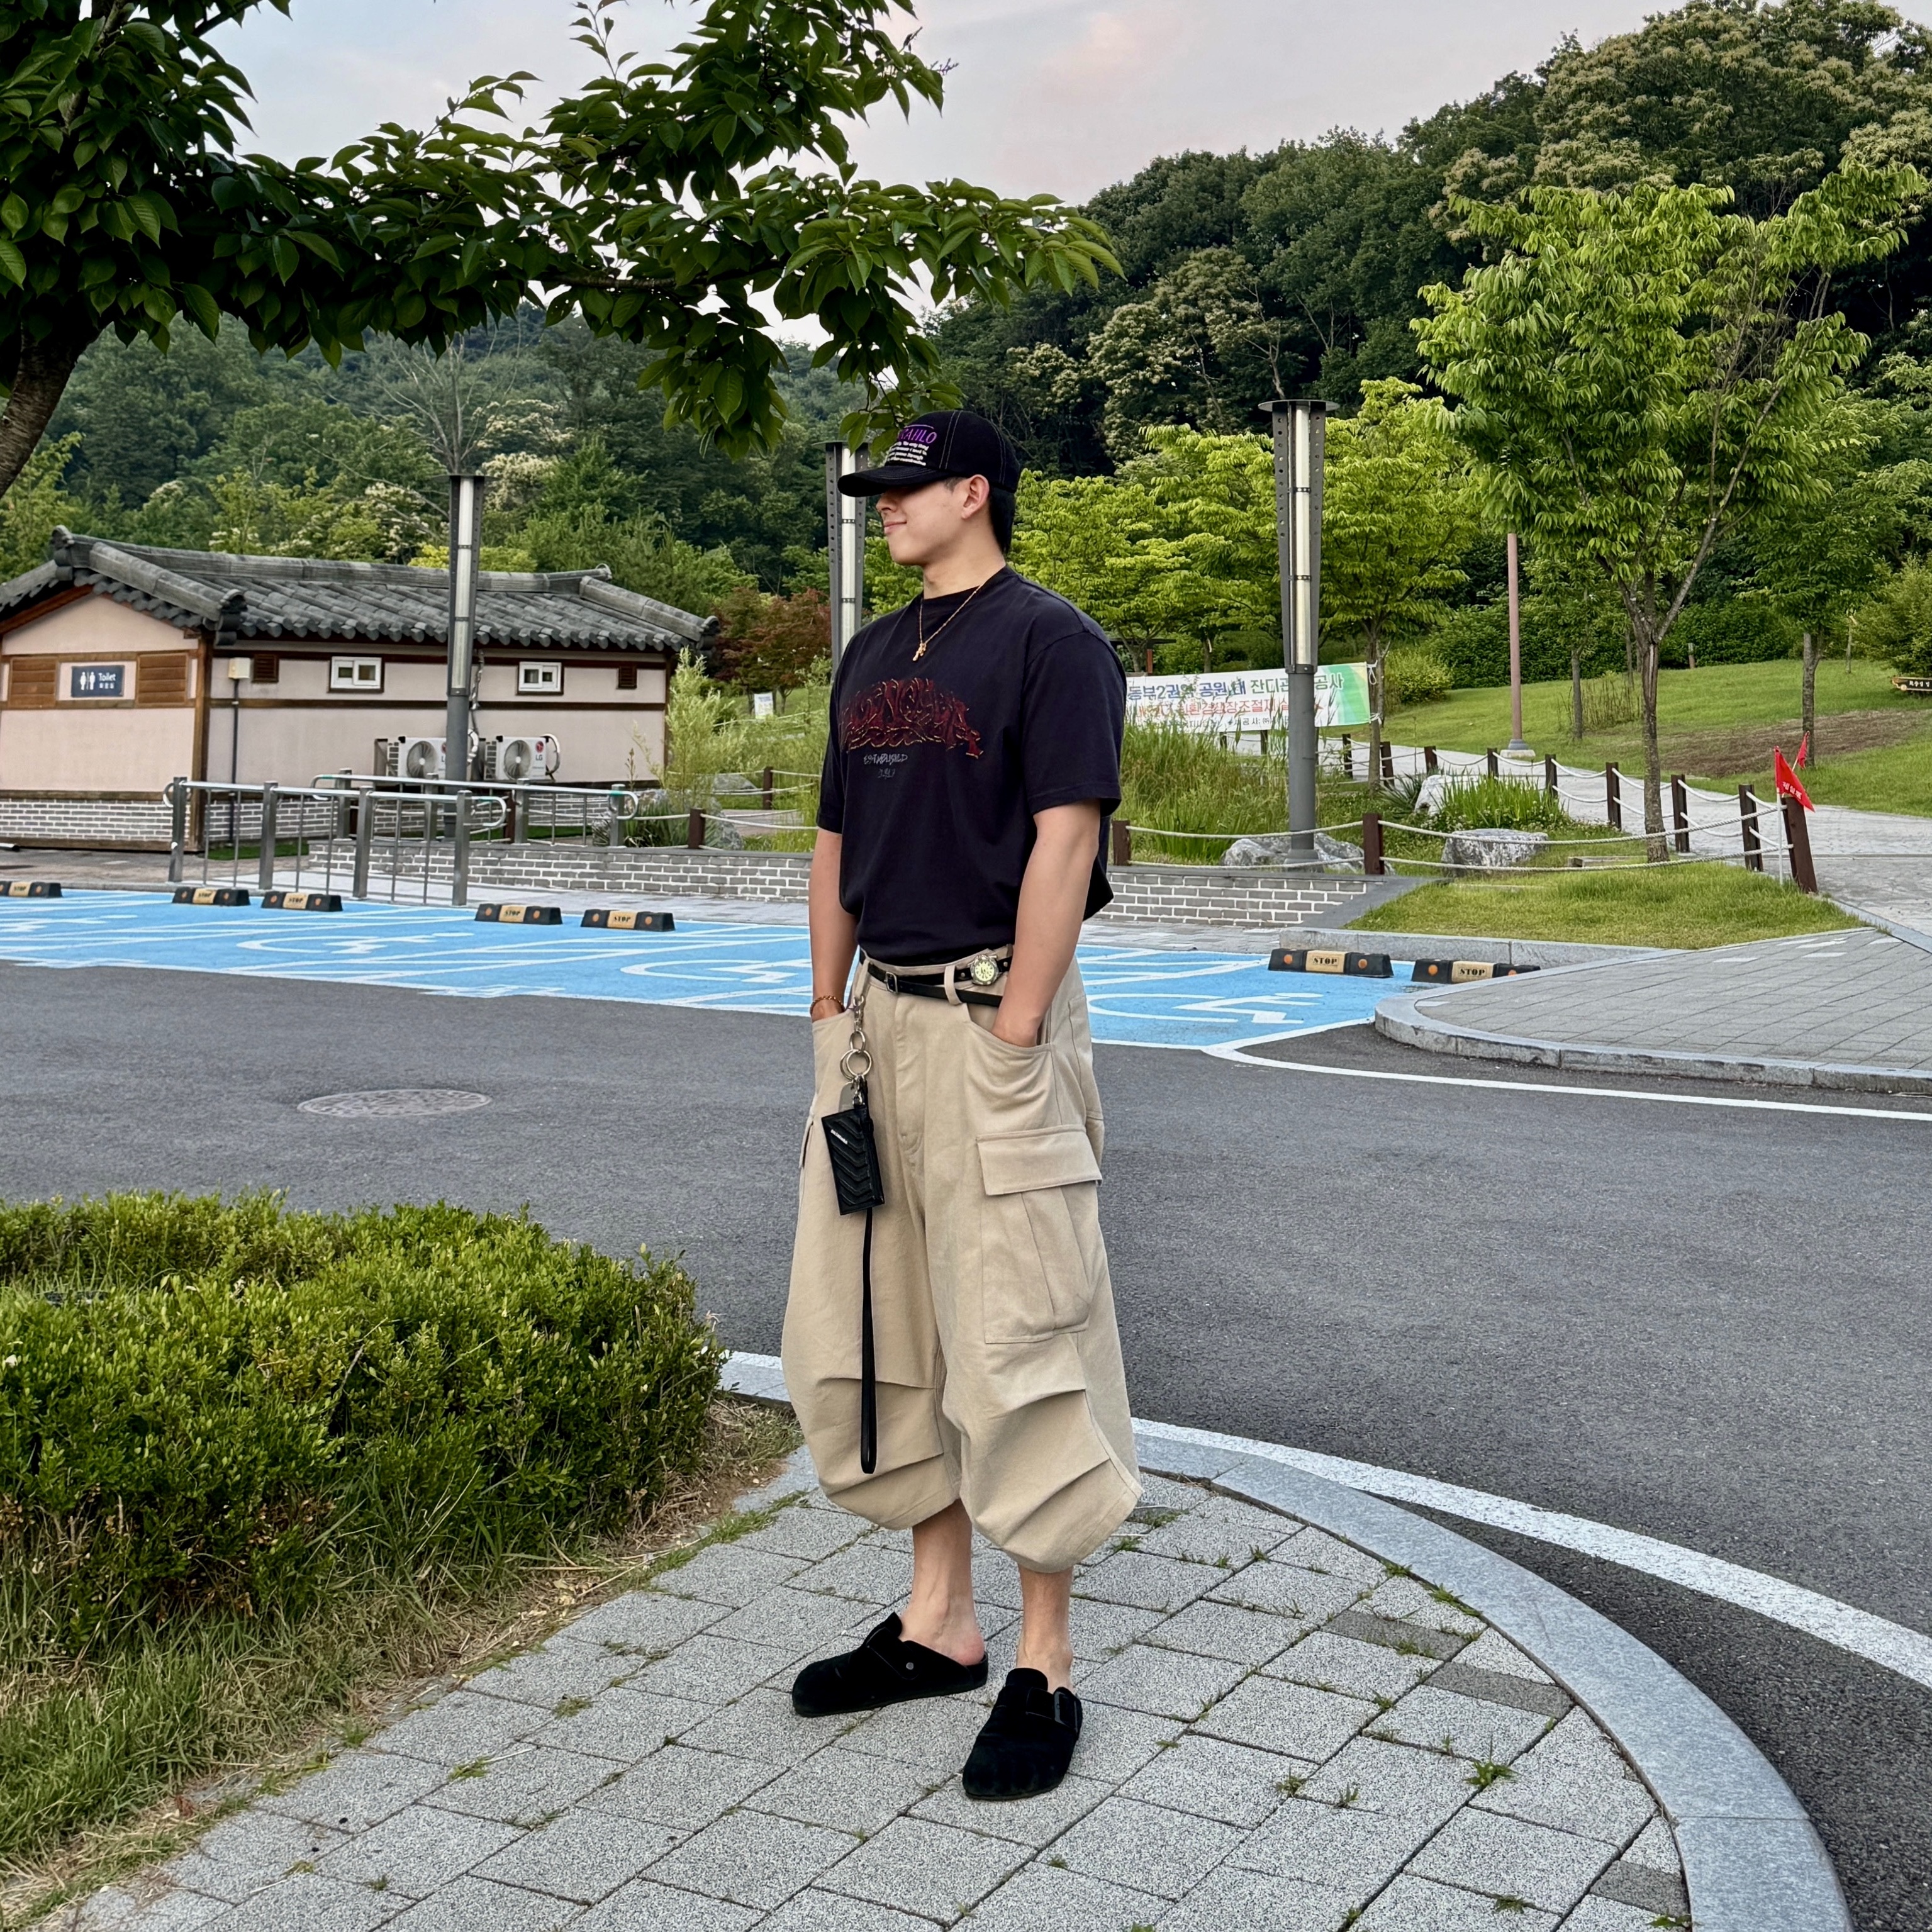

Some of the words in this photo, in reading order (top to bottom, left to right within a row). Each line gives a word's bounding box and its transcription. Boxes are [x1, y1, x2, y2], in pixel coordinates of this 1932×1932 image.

[99, 672, 116, 681] Toilet
[1199, 681, 1226, 697] 공원
[1314, 673, 1344, 690] 공사
